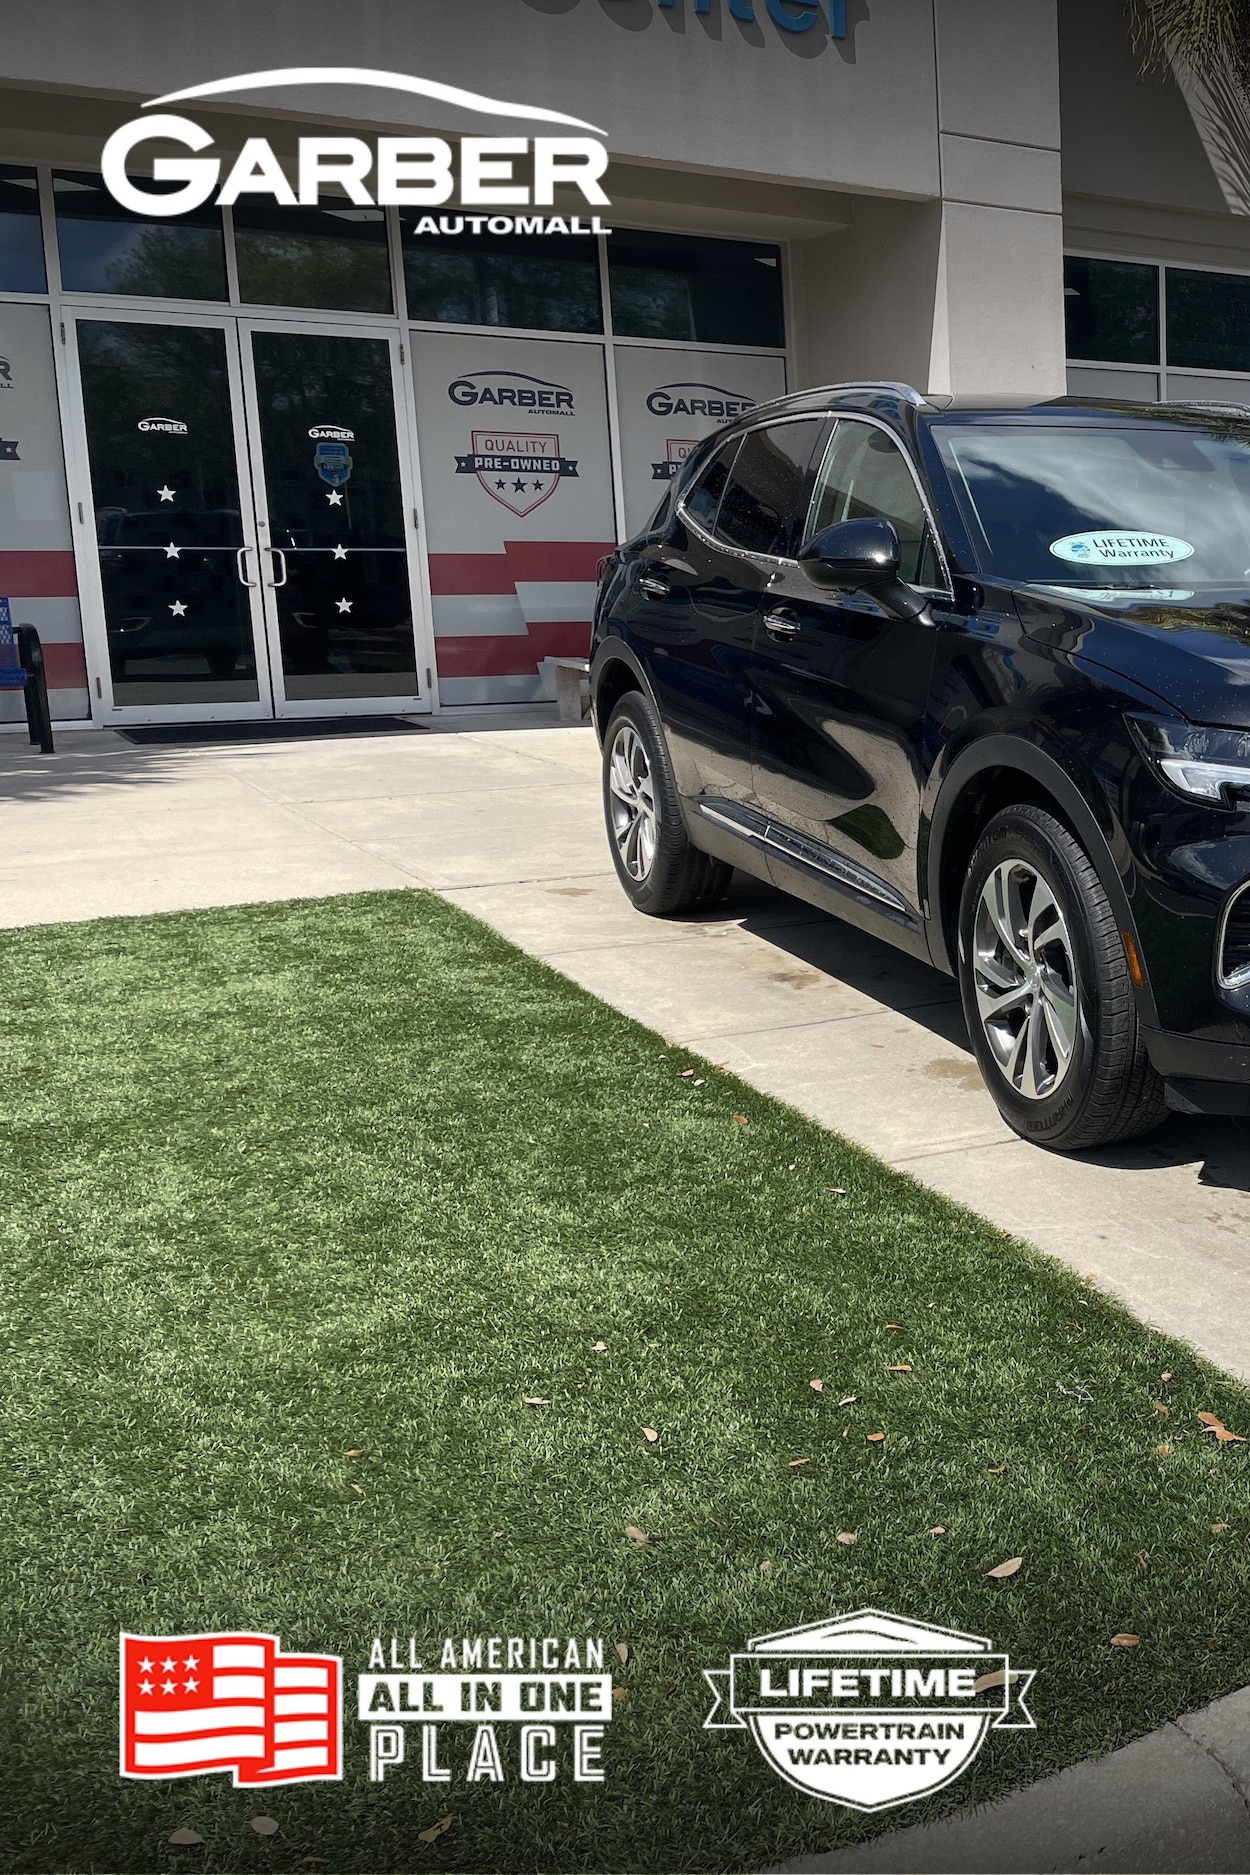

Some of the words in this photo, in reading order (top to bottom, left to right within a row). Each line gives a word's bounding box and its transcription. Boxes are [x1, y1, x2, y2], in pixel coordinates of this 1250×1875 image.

[448, 380, 575, 409] GARBER
[527, 409, 576, 417] AUTOMALL
[138, 421, 188, 432] GARBER
[308, 428, 354, 439] GARBER
[484, 439, 547, 454] QUALITY
[474, 456, 560, 472] PRE-OWNED
[1092, 538, 1169, 547] LIFETIME
[1099, 549, 1174, 559] Warranty
